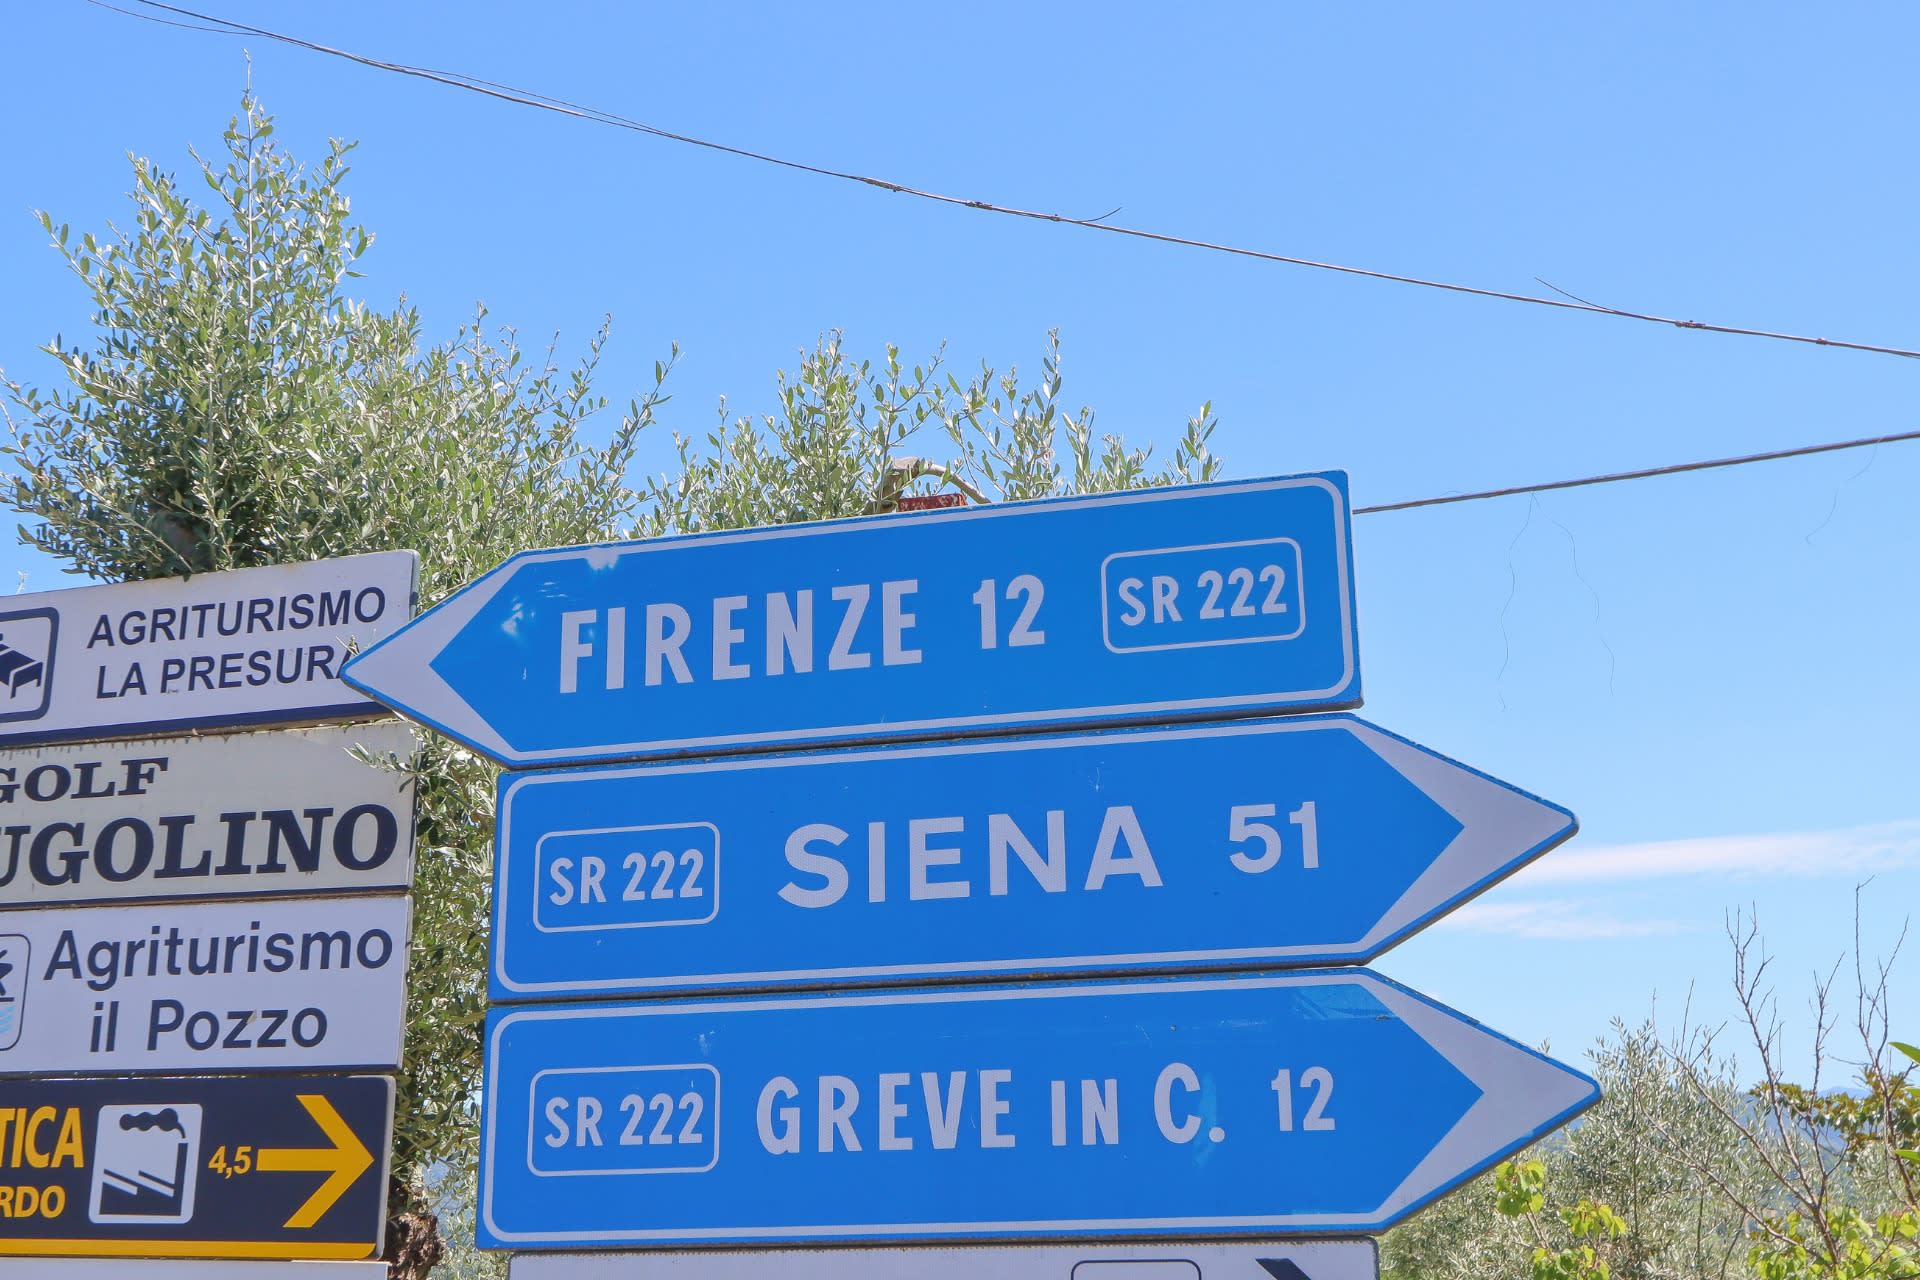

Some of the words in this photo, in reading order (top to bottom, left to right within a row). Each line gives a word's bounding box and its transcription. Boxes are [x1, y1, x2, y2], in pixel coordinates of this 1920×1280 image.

[87, 586, 386, 649] AGRITURISMO
[1118, 576, 1181, 626] SR
[1199, 564, 1288, 620] 222
[559, 579, 923, 694] FIRENZE
[973, 574, 1046, 651] 12
[96, 661, 147, 699] LA
[549, 858, 607, 906] SR
[621, 849, 704, 901] 222
[777, 805, 1163, 909] SIENA
[1228, 800, 1320, 874] 51
[43, 921, 393, 991] Agriturismo
[90, 1000, 119, 1053] il
[147, 999, 328, 1051] Pozzo
[544, 1096, 603, 1149] SR
[619, 1092, 704, 1145] 222
[756, 1068, 1016, 1154] GREVE
[1051, 1078, 1119, 1146] IN
[1154, 1062, 1225, 1144] C.
[1271, 1066, 1336, 1132] 12
[208, 1146, 252, 1179] 4,5
